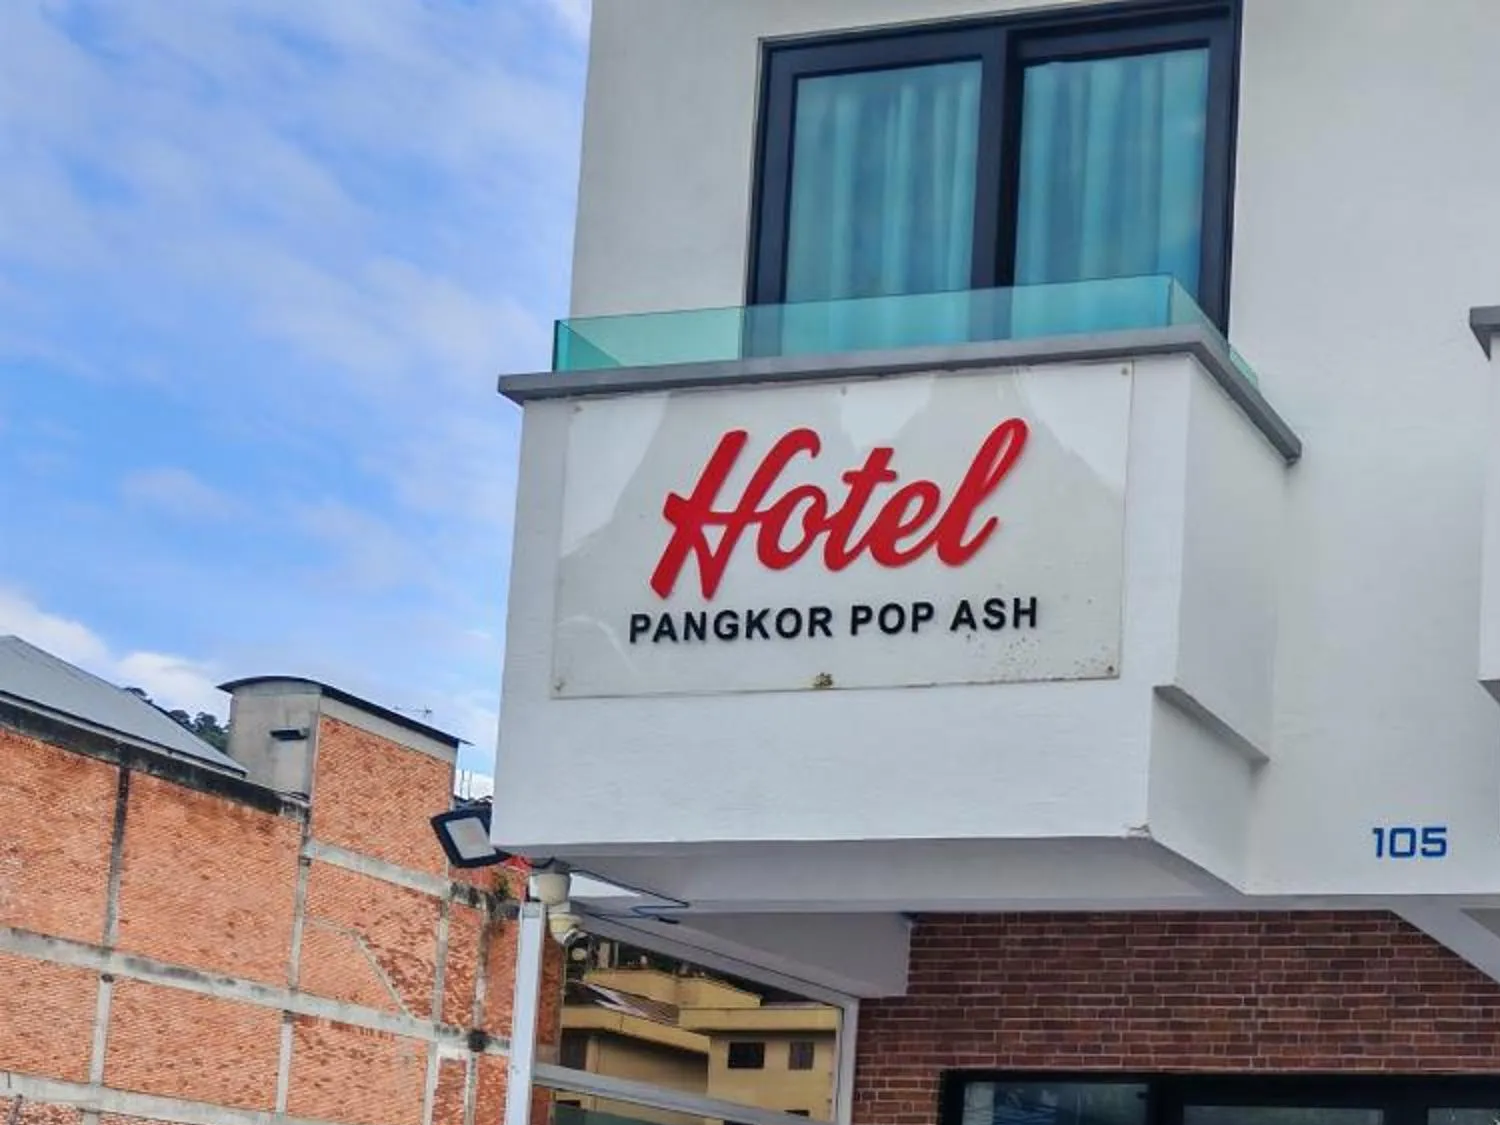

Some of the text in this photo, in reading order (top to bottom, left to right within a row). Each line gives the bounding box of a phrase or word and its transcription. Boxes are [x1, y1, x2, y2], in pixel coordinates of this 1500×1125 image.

[649, 418, 1030, 601] Hotel
[628, 596, 1038, 644] PANGKOR POP ASH
[1372, 827, 1447, 858] 105
